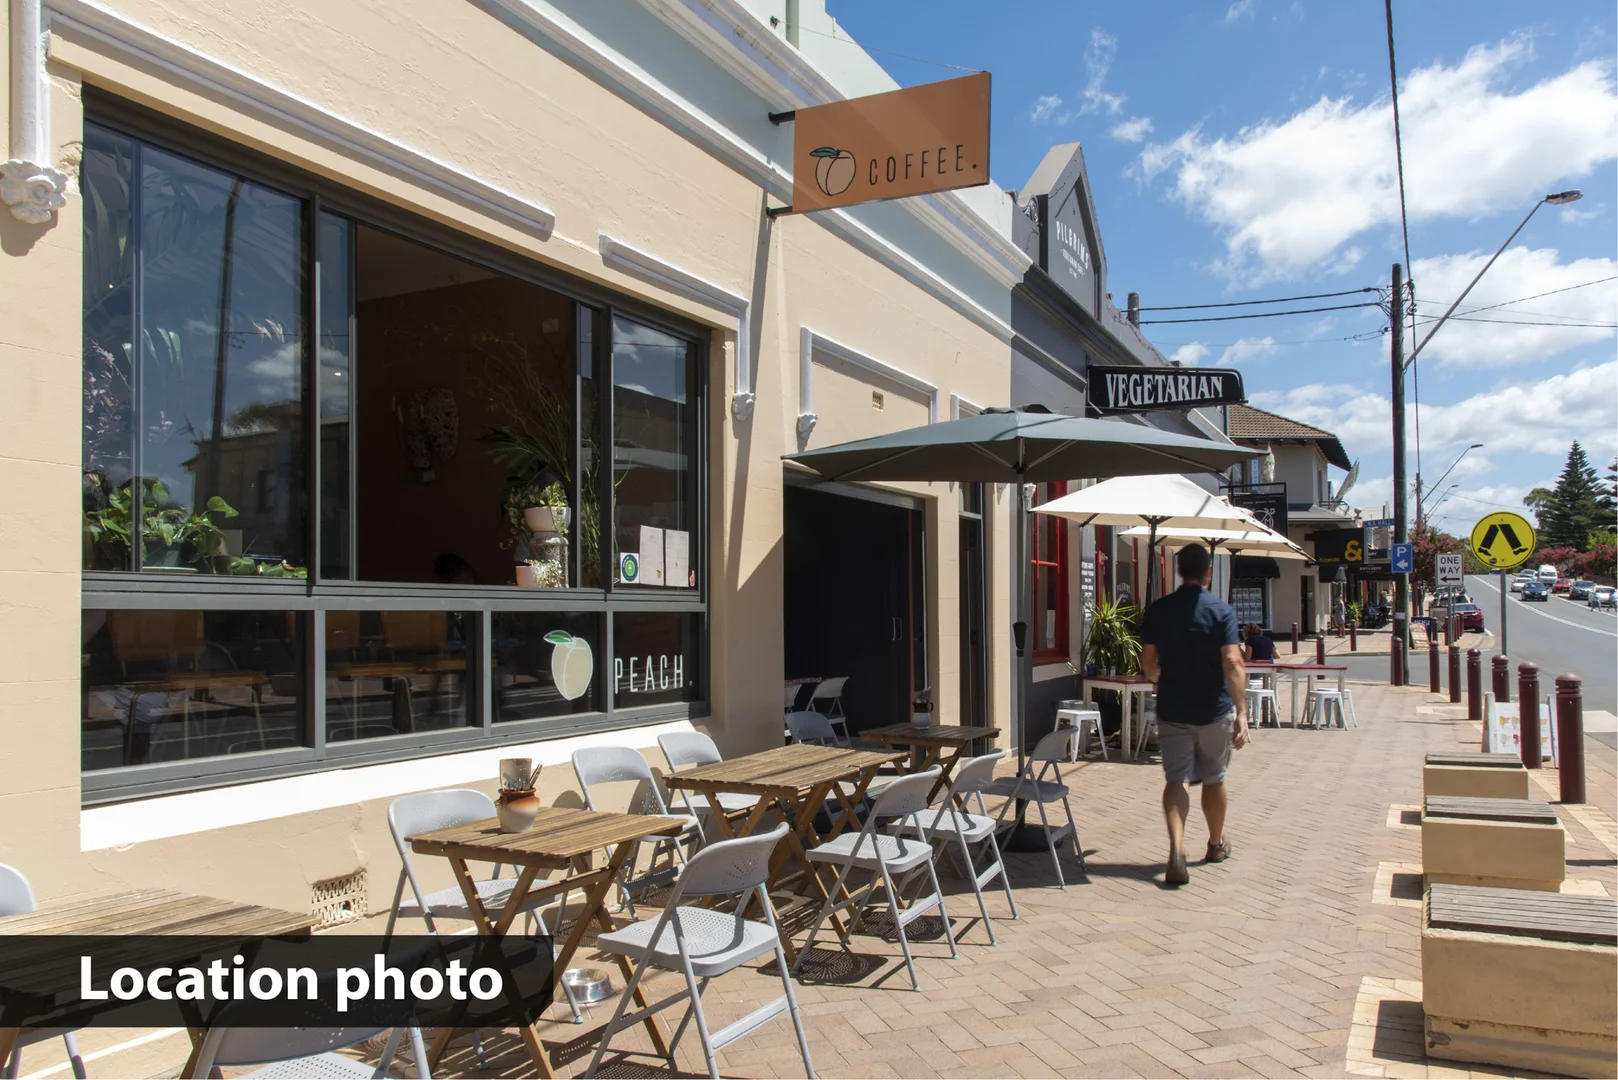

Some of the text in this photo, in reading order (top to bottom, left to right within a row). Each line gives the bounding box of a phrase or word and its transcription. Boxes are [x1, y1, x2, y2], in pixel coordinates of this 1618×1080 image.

[869, 144, 977, 185] COFFEE.
[1105, 373, 1224, 408] VEGETARIAN
[1396, 546, 1407, 558] P
[1440, 556, 1459, 565] ONE
[1440, 566, 1460, 574] WAY
